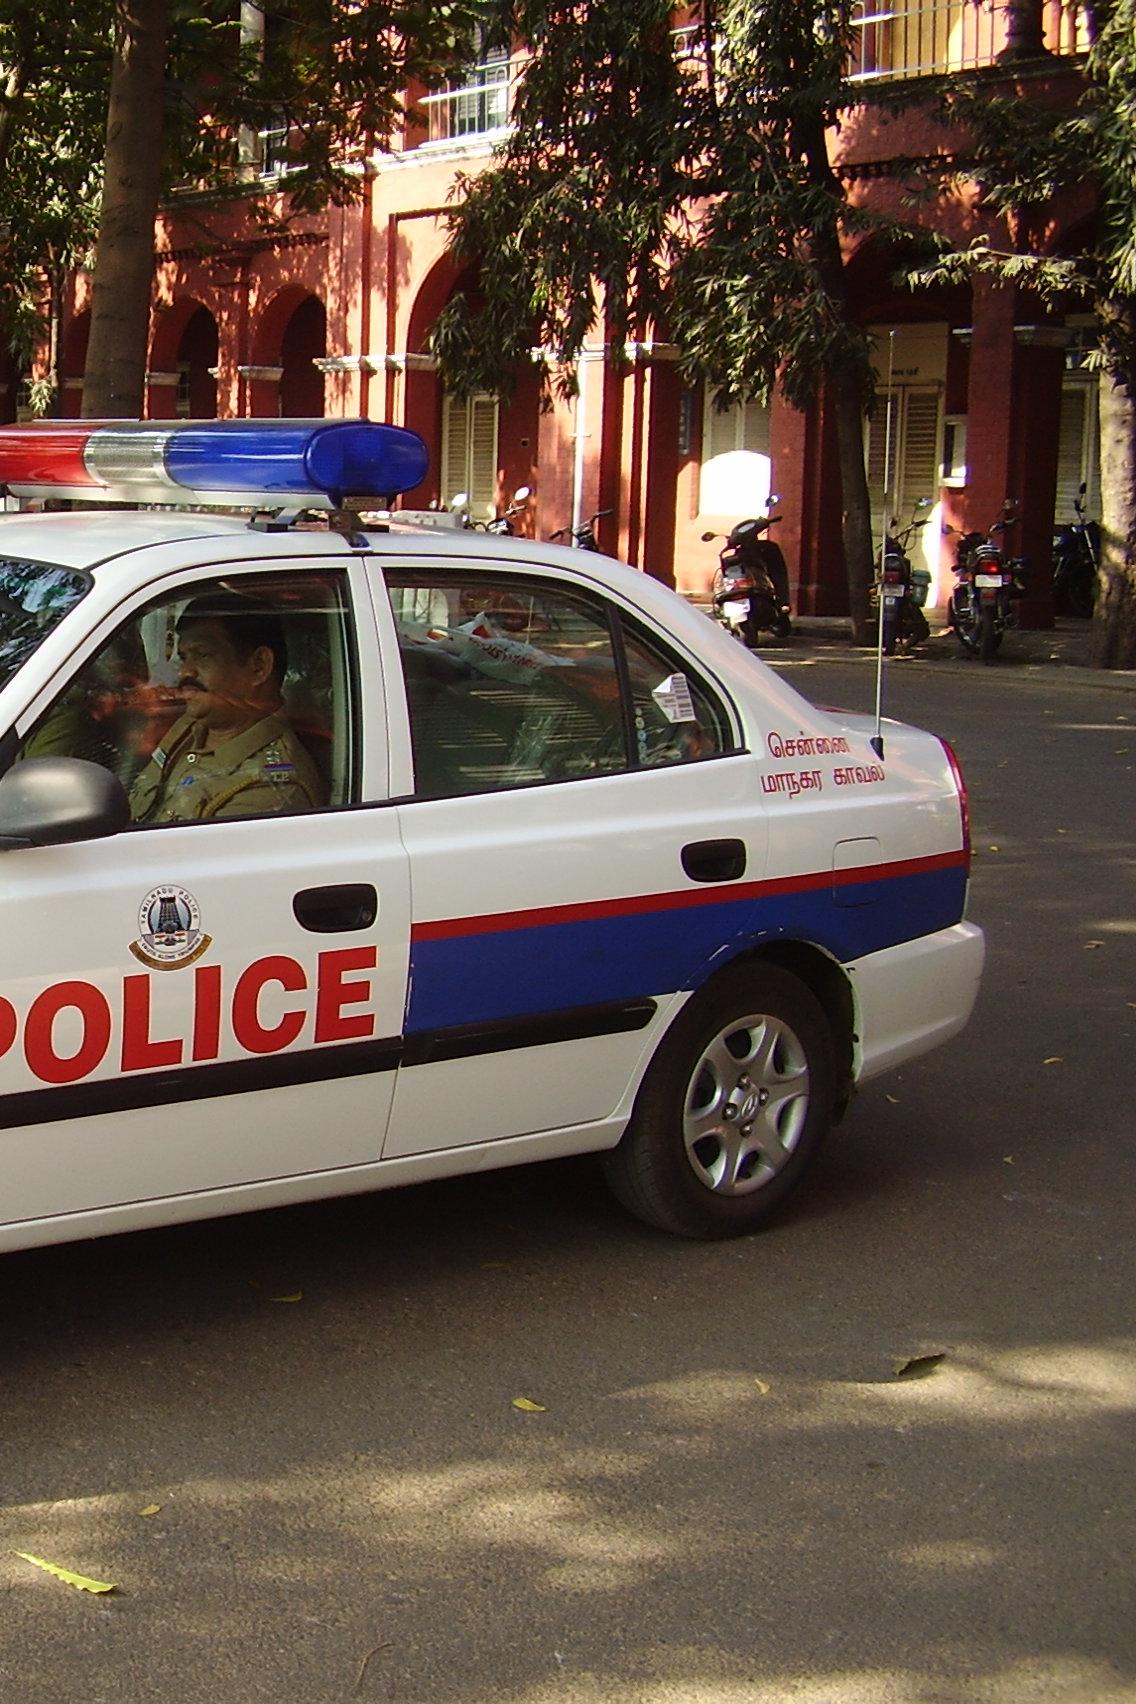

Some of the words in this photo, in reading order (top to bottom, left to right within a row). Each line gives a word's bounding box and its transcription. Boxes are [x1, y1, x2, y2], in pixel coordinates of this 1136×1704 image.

[767, 730, 850, 758] சென்னை
[760, 770, 823, 799] மாநகர
[178, 889, 200, 920] POLICE
